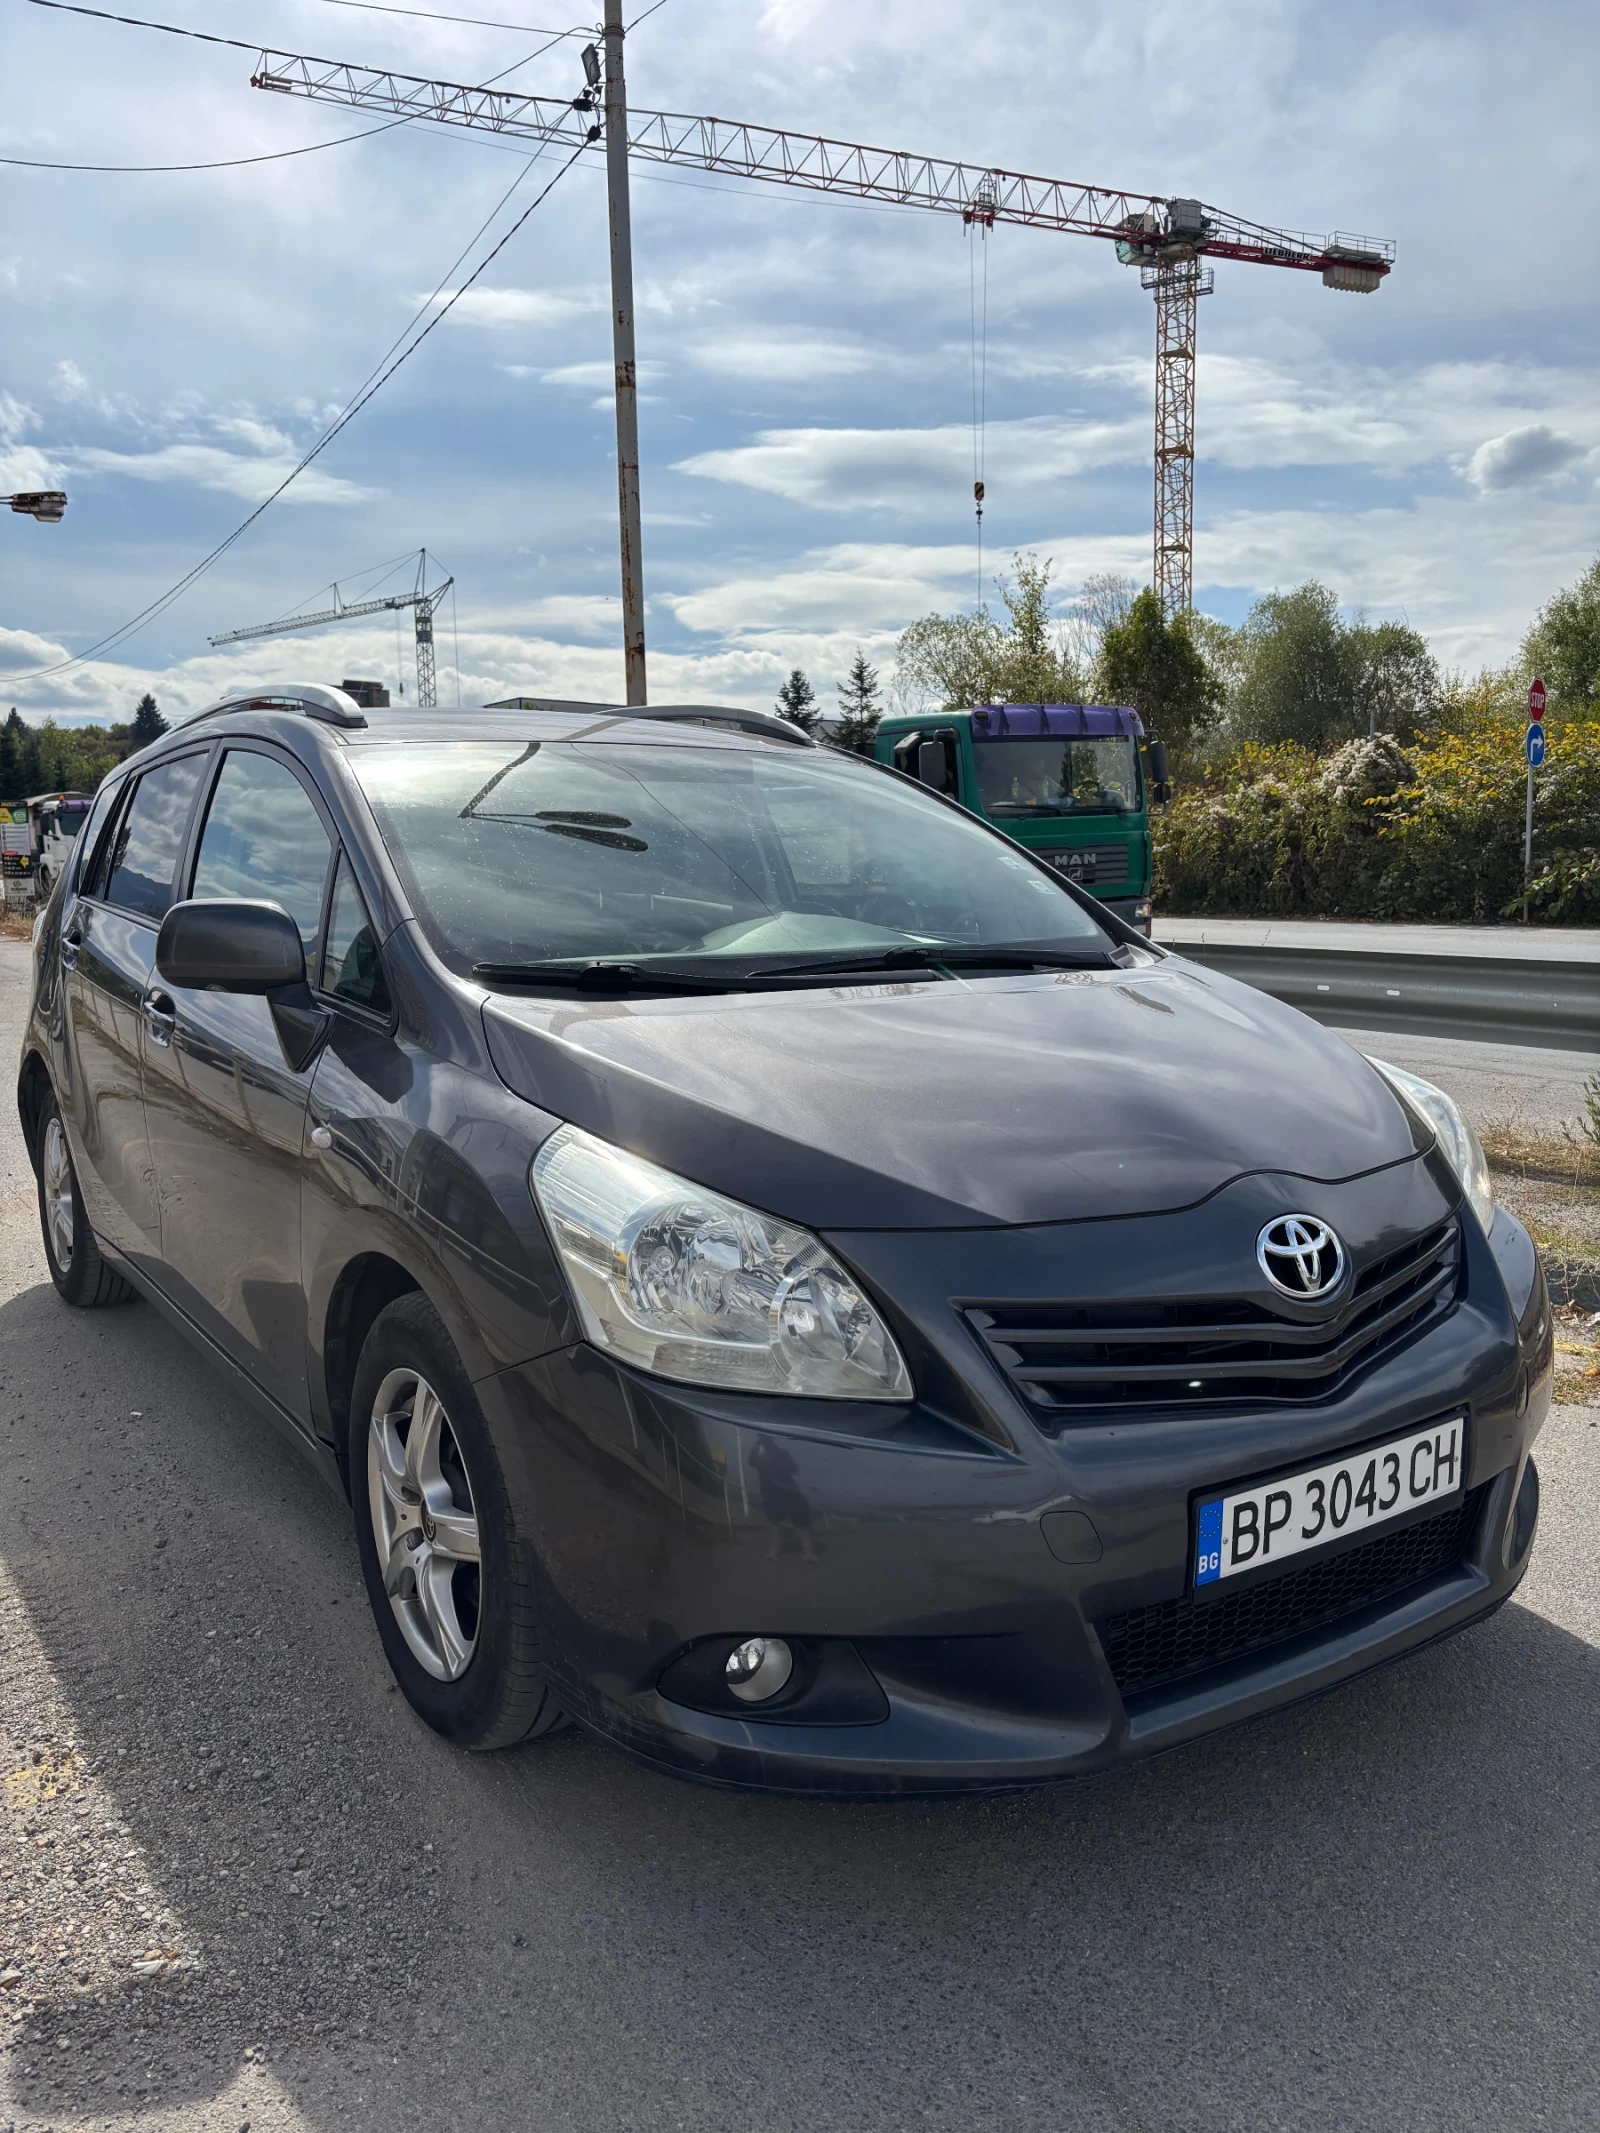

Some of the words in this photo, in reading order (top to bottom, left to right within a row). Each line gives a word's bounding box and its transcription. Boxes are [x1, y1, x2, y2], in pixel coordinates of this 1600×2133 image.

[1264, 247, 1310, 260] LIEBHERR
[1531, 692, 1545, 709] STOP
[1055, 854, 1096, 866] MAN
[1230, 1490, 1292, 1565] BP
[1301, 1452, 1400, 1540] 3043
[1409, 1428, 1457, 1499] CH
[1198, 1551, 1219, 1575] BG
